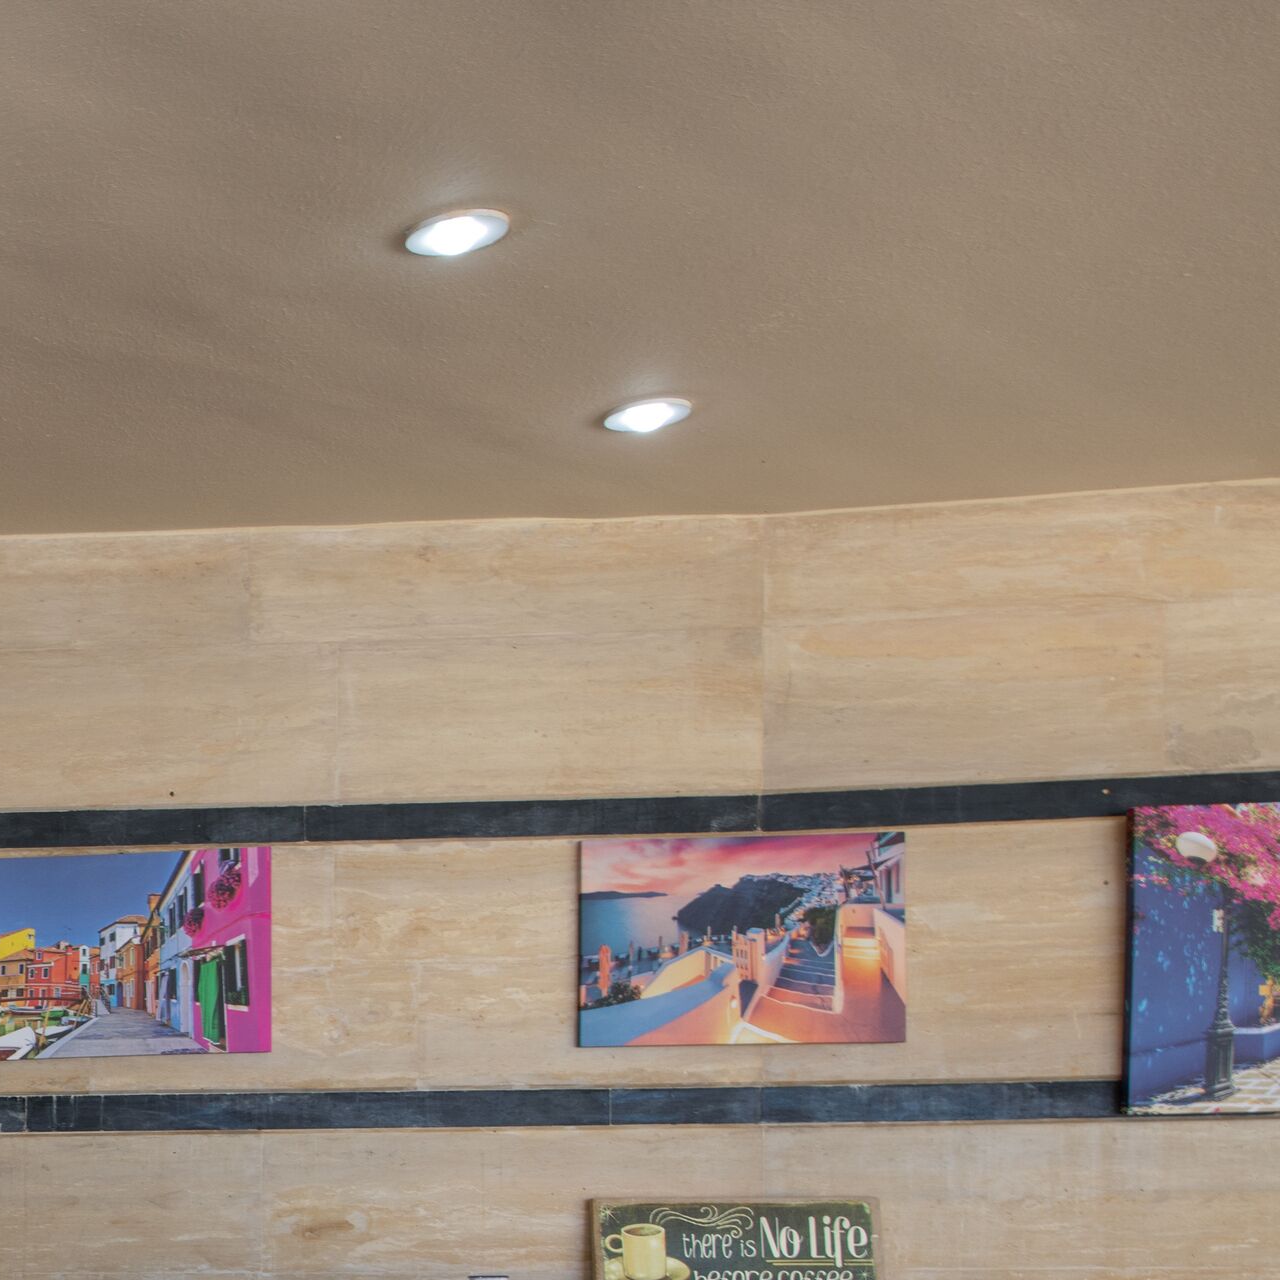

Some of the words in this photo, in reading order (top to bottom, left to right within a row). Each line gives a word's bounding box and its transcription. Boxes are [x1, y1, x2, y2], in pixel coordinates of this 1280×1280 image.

[682, 1233, 734, 1259] there
[740, 1238, 758, 1258] is
[759, 1215, 803, 1259] No
[808, 1215, 868, 1268] Life
